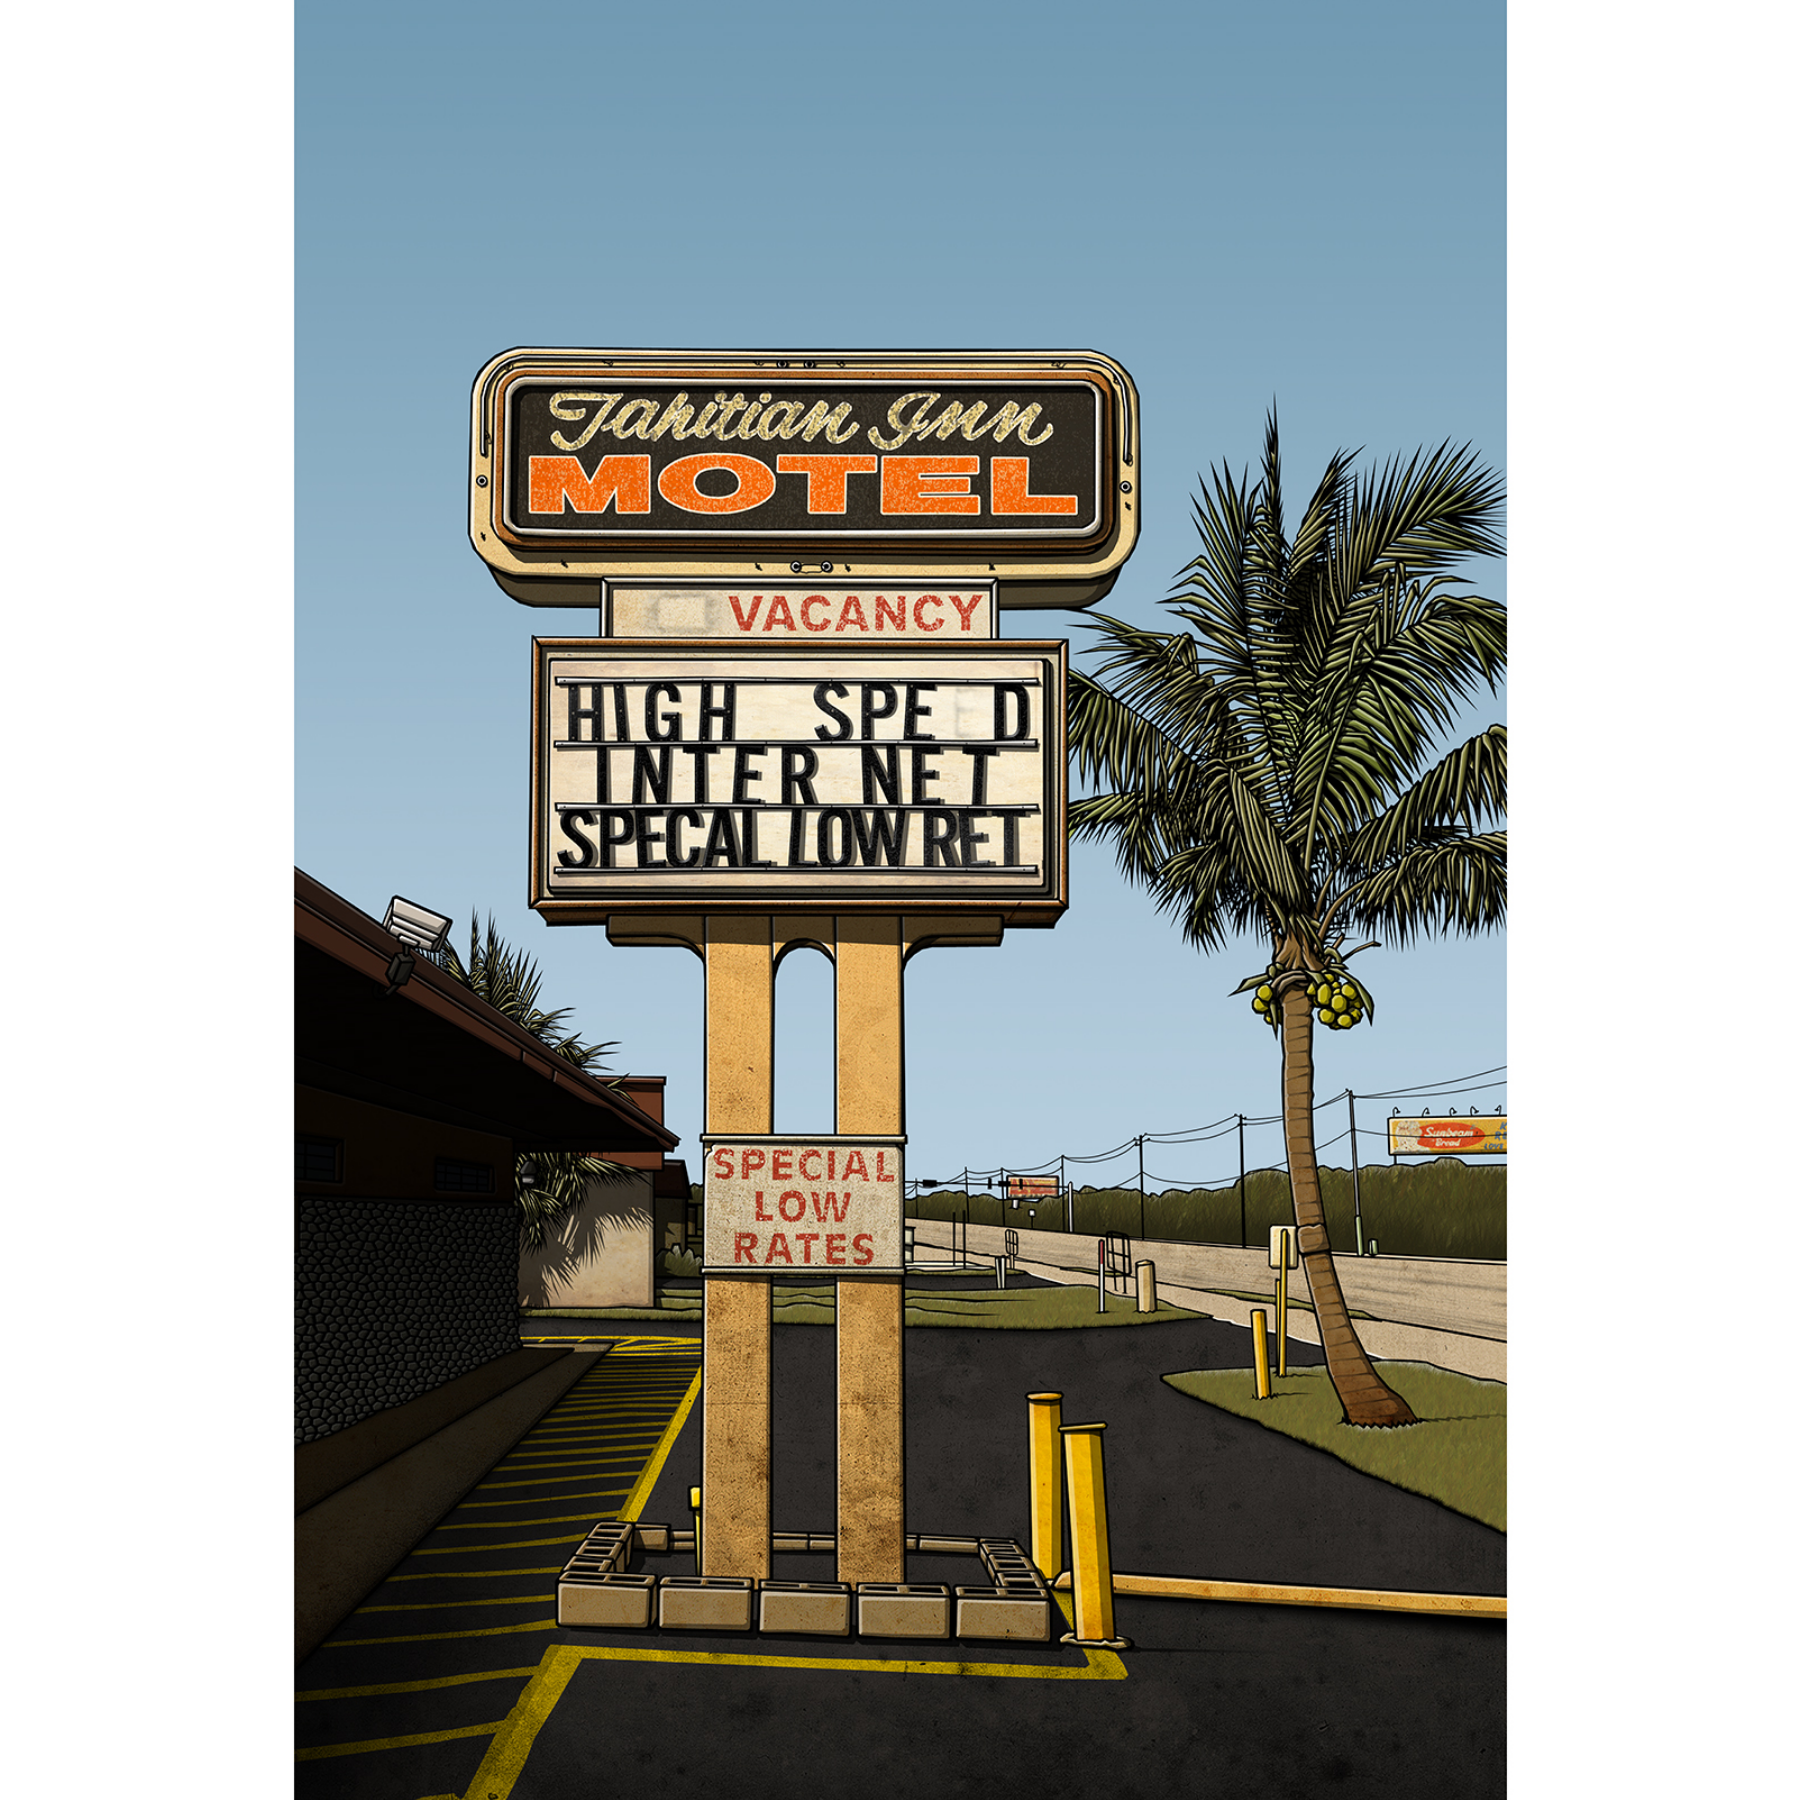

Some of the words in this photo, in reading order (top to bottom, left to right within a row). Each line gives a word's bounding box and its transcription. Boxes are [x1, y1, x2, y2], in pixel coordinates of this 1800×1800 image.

[549, 390, 858, 451] Tahitian
[867, 389, 1053, 451] Inn
[528, 453, 1078, 515] MOTEL
[729, 595, 983, 631] VACANCY
[568, 683, 735, 741] HIGH
[557, 808, 777, 868] SPECAL
[788, 808, 909, 868] LOW
[922, 808, 1030, 868] RET
[1424, 1126, 1474, 1138] Sunbeam
[1434, 1138, 1461, 1147] Bread
[713, 1148, 895, 1182] SPECIAL
[755, 1190, 851, 1222] LOW
[734, 1232, 874, 1265] RATES
